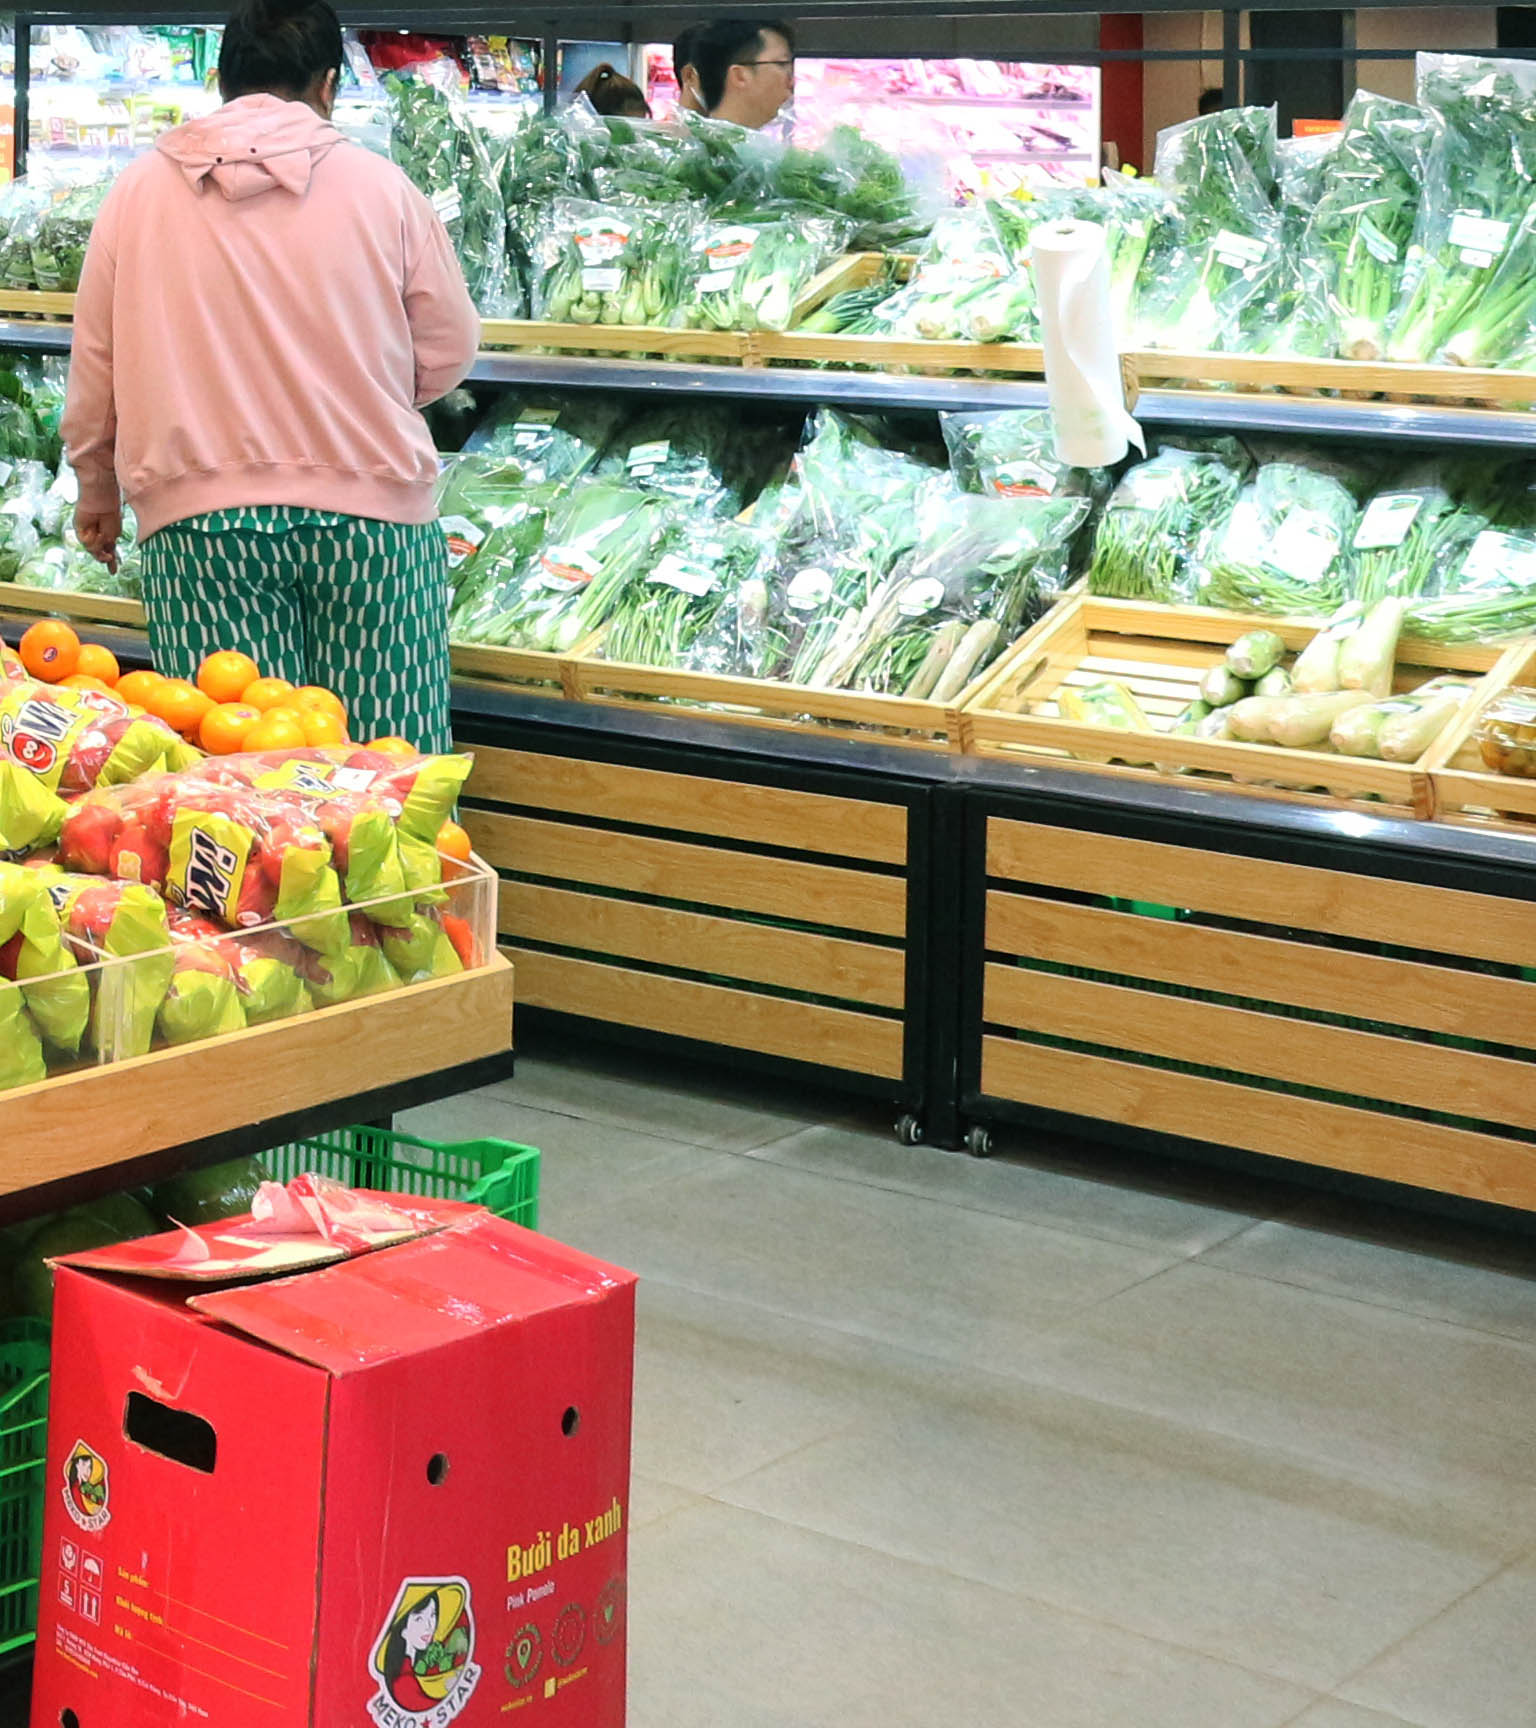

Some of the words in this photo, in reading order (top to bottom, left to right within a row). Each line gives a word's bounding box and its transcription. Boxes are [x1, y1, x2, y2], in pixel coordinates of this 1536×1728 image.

[507, 1531, 552, 1582] Bưởi
[557, 1523, 580, 1560] da
[585, 1497, 622, 1548] xanh
[507, 1594, 525, 1611] Pink
[436, 1668, 477, 1724] STAR
